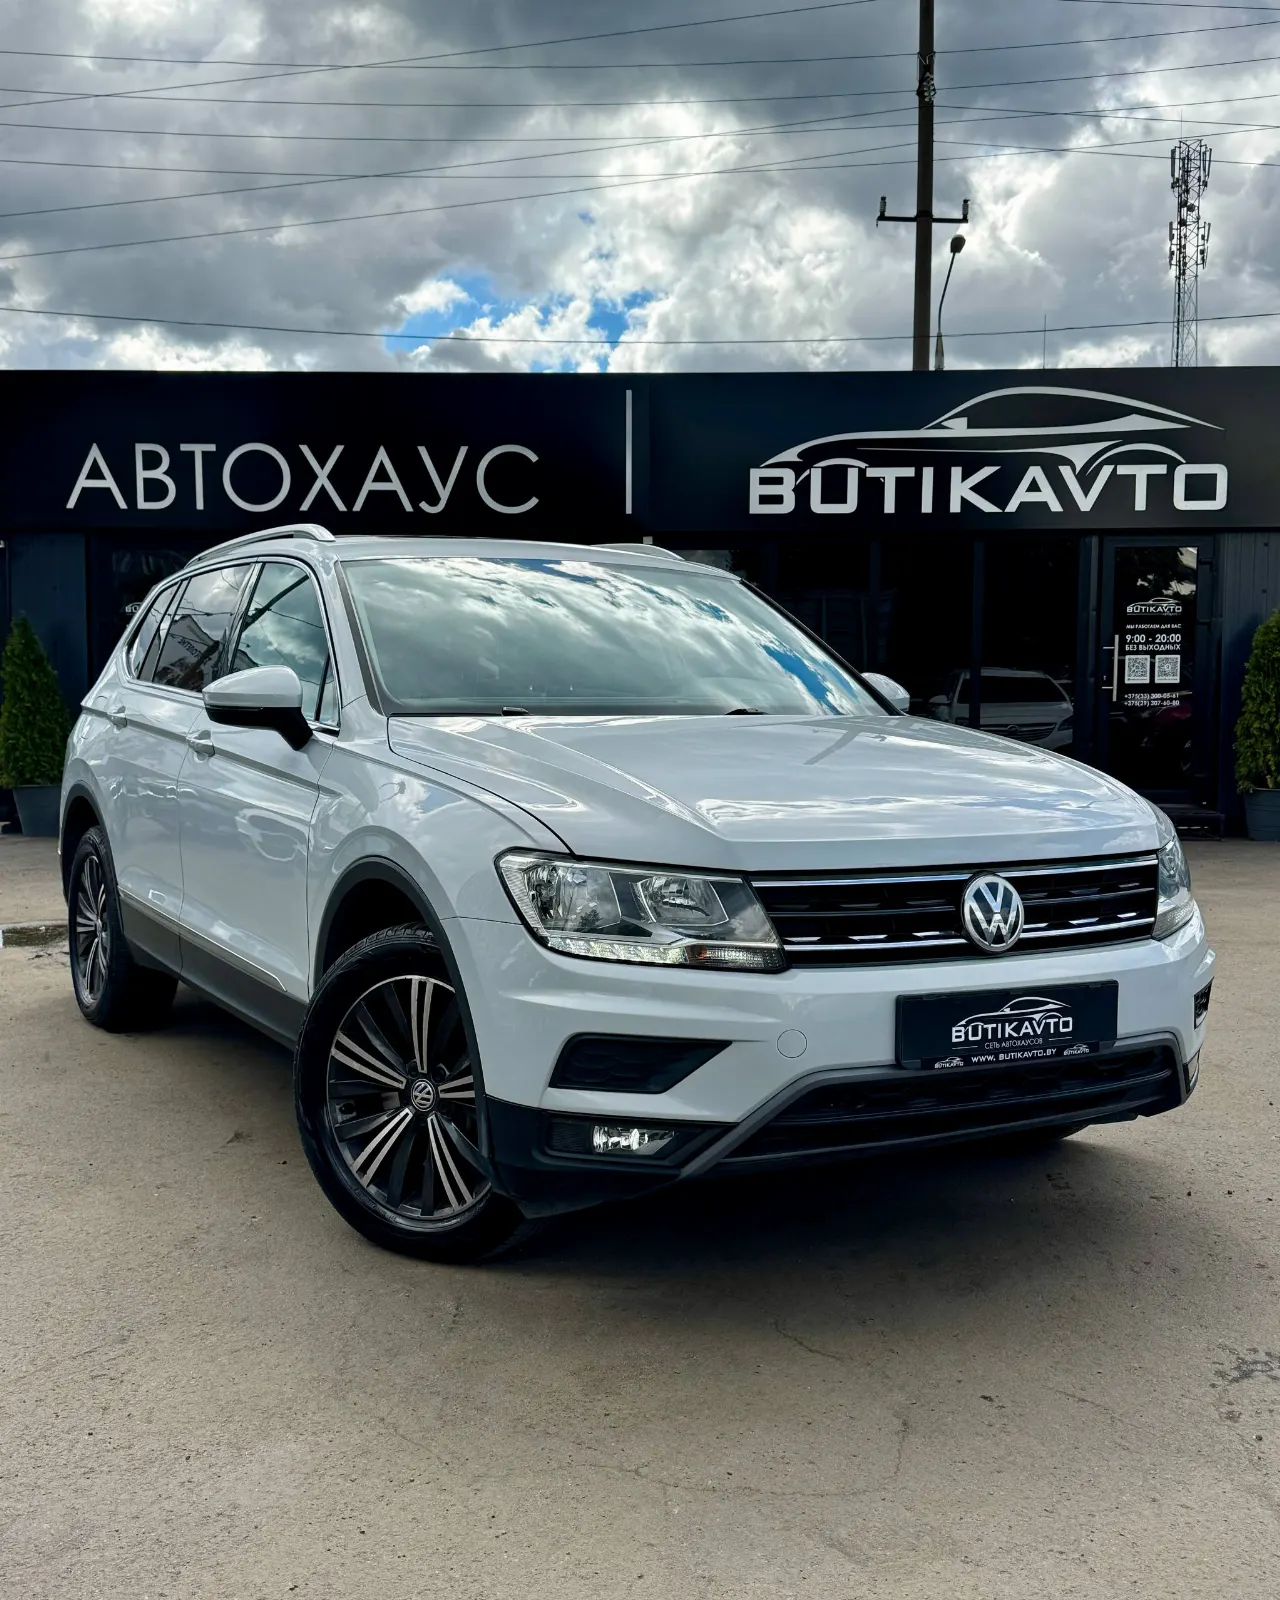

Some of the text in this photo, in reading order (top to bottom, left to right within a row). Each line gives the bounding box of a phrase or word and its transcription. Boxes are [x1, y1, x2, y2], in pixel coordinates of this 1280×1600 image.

[66, 442, 540, 514] АВТОХАУС
[749, 463, 1229, 514] BUTIKAVTO
[1126, 605, 1183, 613] BUTIKAVTO
[1125, 634, 1146, 643] 9:00
[1155, 633, 1181, 643] 20:00
[951, 1016, 1073, 1043] BUTIKAVTO
[984, 1037, 1043, 1050] СЕТЬ АВТОХАУСОВ
[971, 1048, 1057, 1063] WWW. BUTIKAVTO.BY
